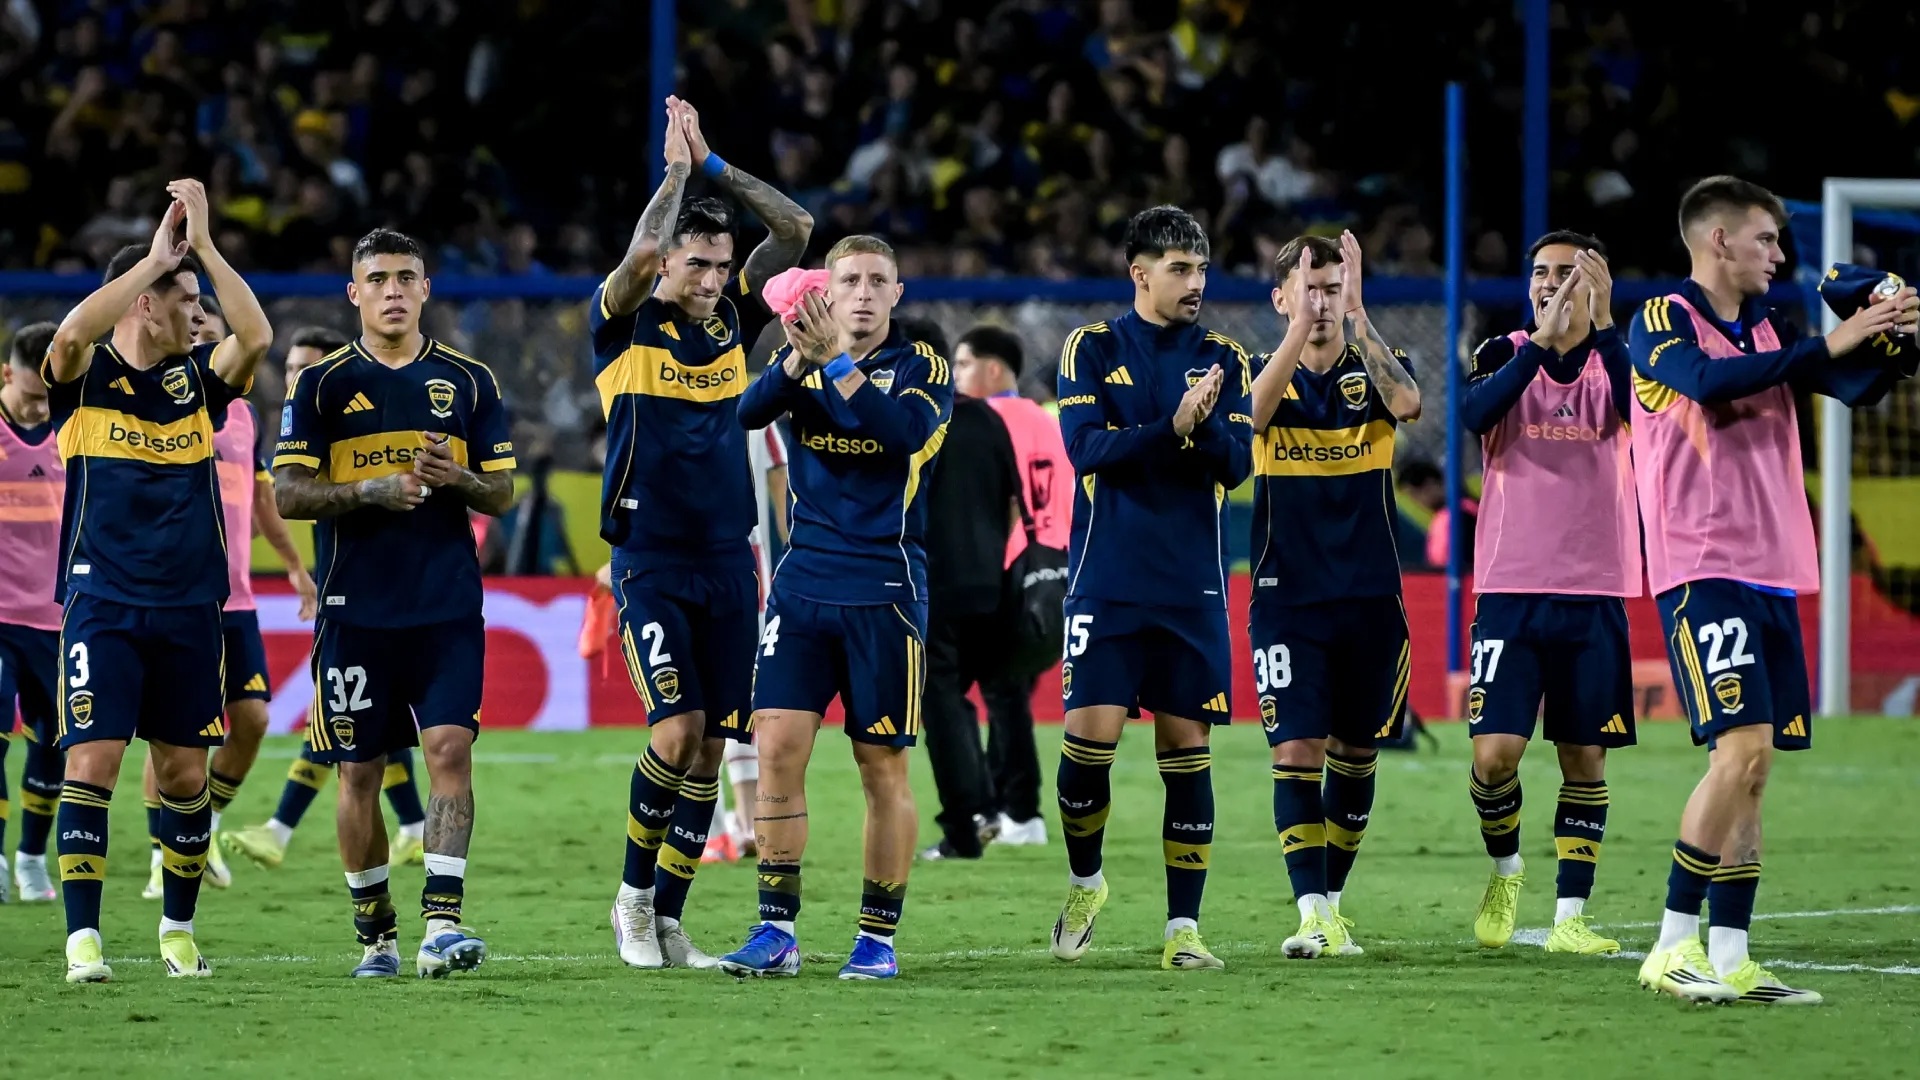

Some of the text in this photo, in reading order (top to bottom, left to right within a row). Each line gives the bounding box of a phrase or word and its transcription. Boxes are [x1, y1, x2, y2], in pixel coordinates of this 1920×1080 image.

[168, 380, 185, 390] CABJ
[660, 362, 738, 389] btsso
[1346, 386, 1363, 394] CABJ
[1058, 395, 1096, 410] TROGAR
[1229, 413, 1255, 428] CETR
[1520, 421, 1603, 441] etsso
[109, 422, 202, 453] betsson
[1275, 441, 1372, 462] betsson
[642, 622, 672, 667] 2
[756, 615, 780, 656] 4
[1062, 614, 1094, 661] 15
[1698, 617, 1755, 674] 22
[69, 642, 89, 688] 3
[1253, 643, 1292, 693] 38
[1470, 639, 1504, 685] 37
[326, 665, 373, 713] 32
[63, 830, 100, 842] CABJ
[674, 826, 708, 843] CAB
[1172, 822, 1212, 831] CABJ
[1565, 817, 1604, 831] CABJ
